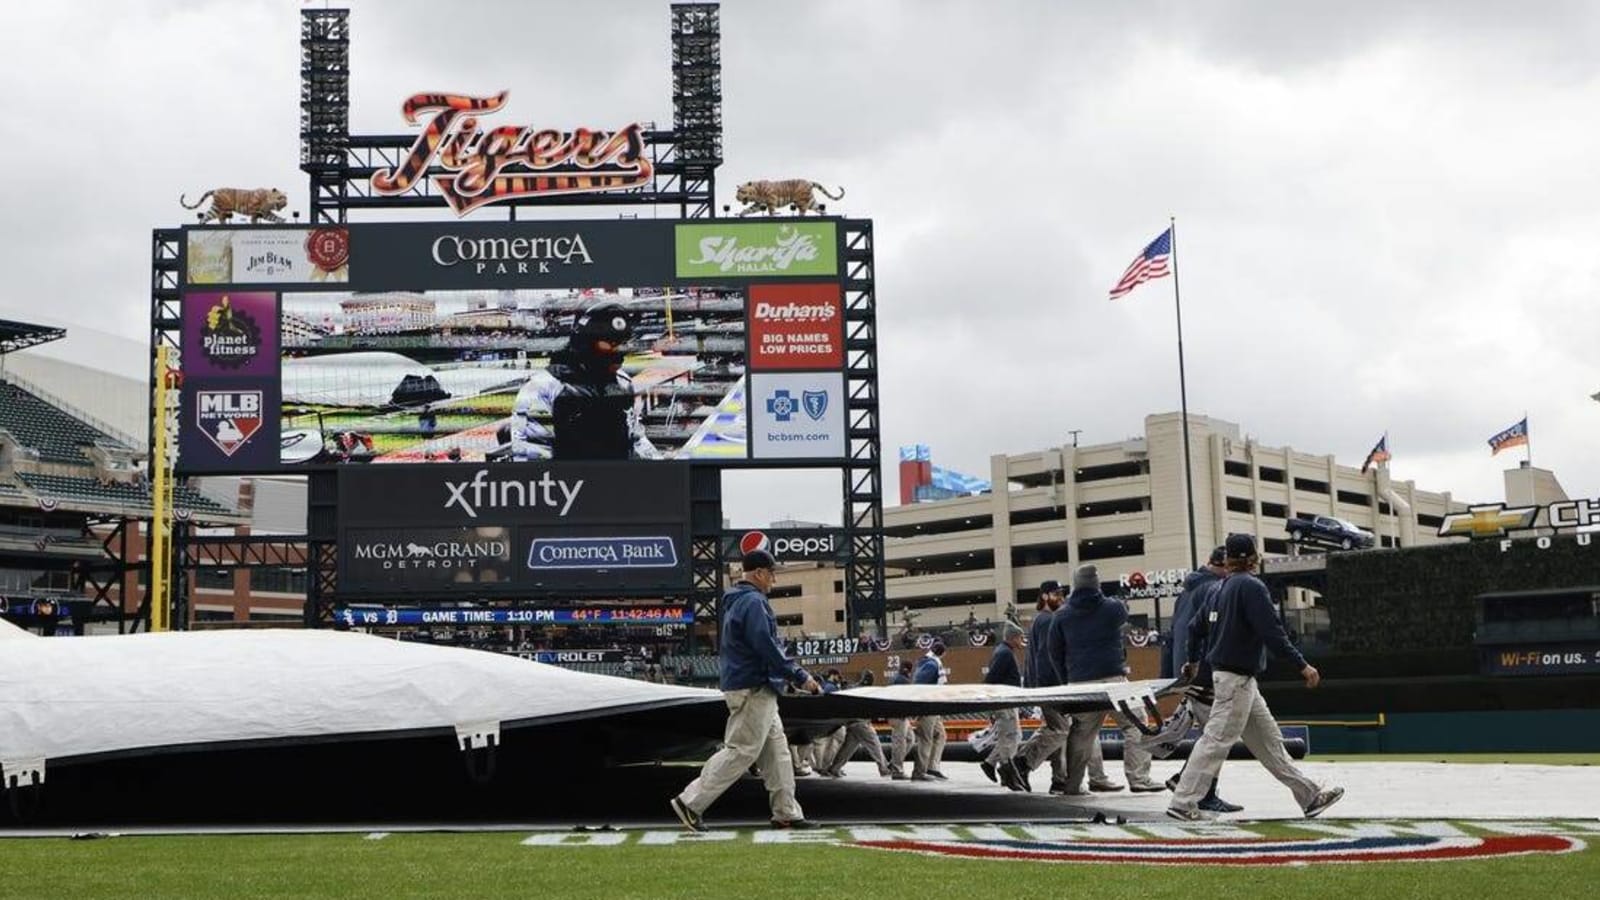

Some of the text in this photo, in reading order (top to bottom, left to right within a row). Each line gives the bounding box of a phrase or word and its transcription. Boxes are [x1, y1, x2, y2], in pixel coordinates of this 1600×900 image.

[370, 90, 654, 217] Tigers
[432, 233, 594, 266] Comerica
[477, 262, 551, 274] PARK
[737, 263, 777, 273] HALAL
[755, 302, 836, 319] Dunham's
[204, 334, 248, 348] planet
[763, 333, 830, 343] BIG NAMES
[209, 343, 257, 355] fitness
[760, 344, 833, 354] LOW PRICES
[201, 394, 259, 412] MLB
[768, 432, 830, 442] bcbsm.com
[444, 469, 584, 518] xfinity
[355, 542, 504, 559] MGM GRAND
[774, 534, 834, 556] pepsi
[540, 543, 664, 563] Comerica Bank
[383, 559, 478, 569] DETROIT
[363, 612, 378, 622] VS
[422, 610, 555, 622] GAME TIME: 1:10 PM
[611, 609, 661, 619] 11:42:46
[664, 609, 683, 618] AM
[797, 638, 859, 656] 502 2987
[887, 655, 900, 668] 23
[1501, 652, 1541, 667] Wi-Fi
[1542, 654, 1560, 665] on
[1564, 653, 1587, 664] us.
